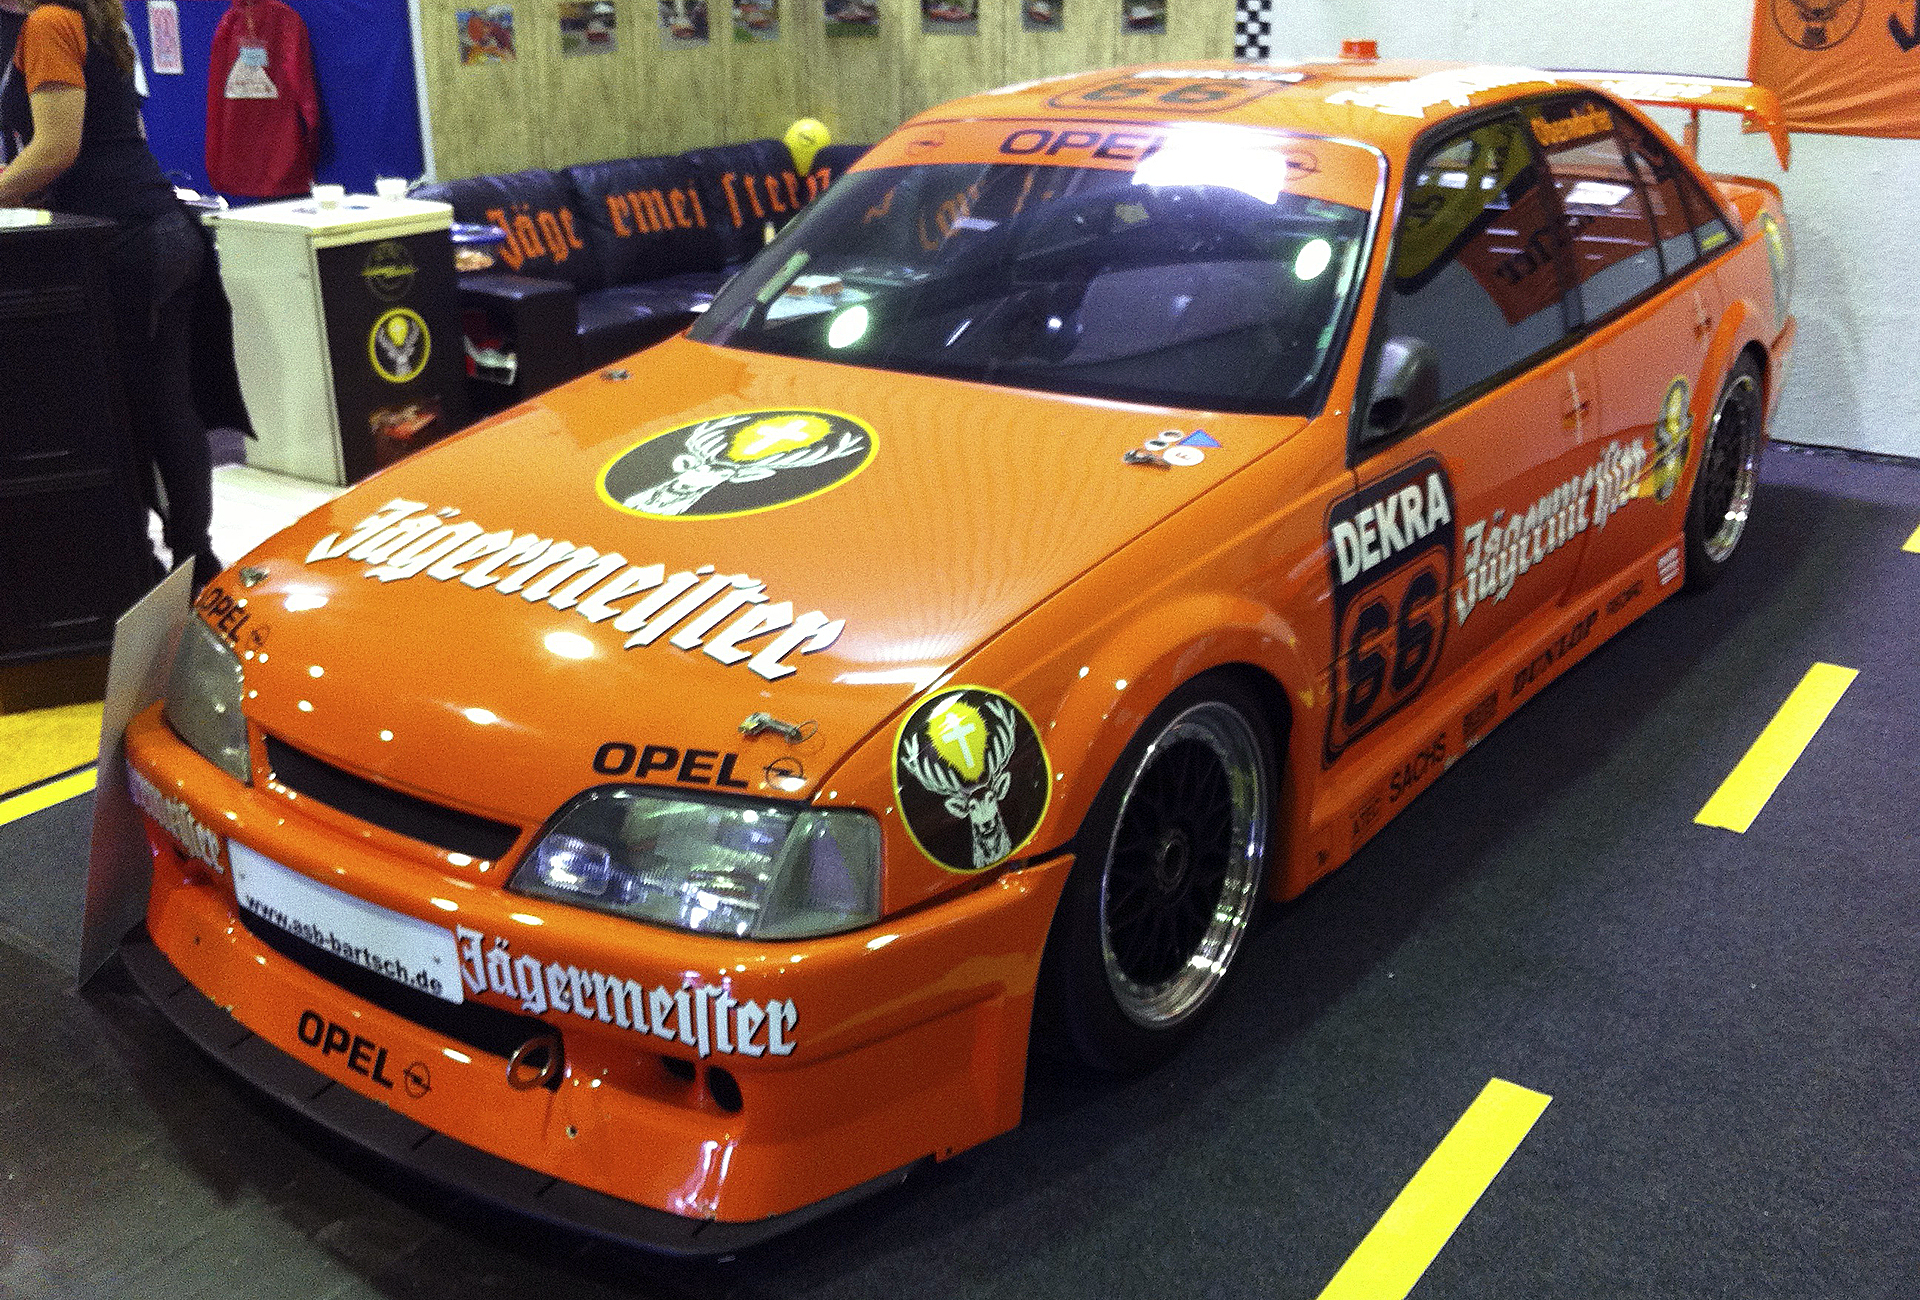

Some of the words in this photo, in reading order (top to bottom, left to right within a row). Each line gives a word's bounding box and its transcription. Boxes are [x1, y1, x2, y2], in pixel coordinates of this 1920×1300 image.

[1331, 471, 1452, 586] DEKRA
[199, 586, 251, 644] OPEL
[305, 497, 847, 682] Jägermeister
[1341, 567, 1440, 731] 66
[592, 741, 749, 789] OPEL
[1389, 731, 1447, 803] SACHS
[246, 894, 444, 996] www.asb-bartsch.de
[456, 923, 799, 1060] Jägermeister
[297, 1008, 395, 1090] OPEL
